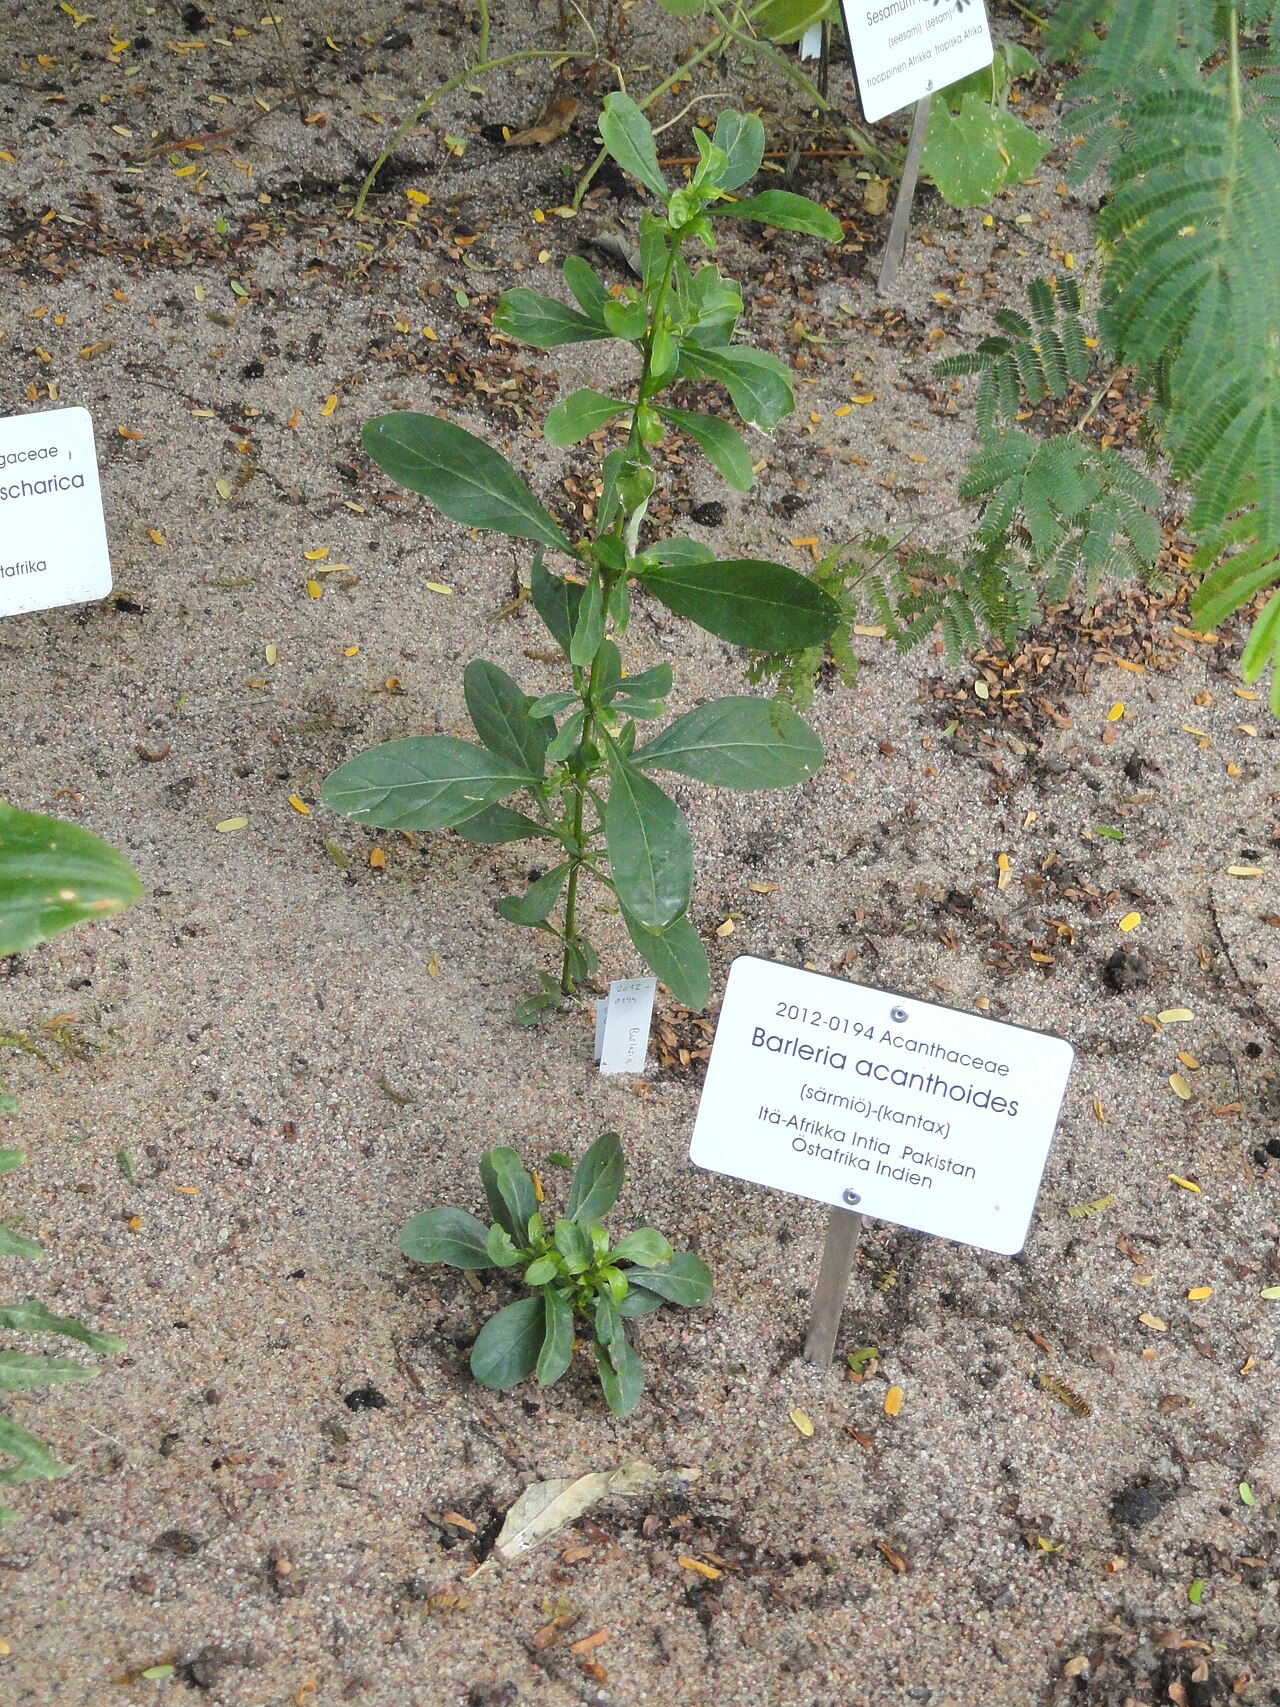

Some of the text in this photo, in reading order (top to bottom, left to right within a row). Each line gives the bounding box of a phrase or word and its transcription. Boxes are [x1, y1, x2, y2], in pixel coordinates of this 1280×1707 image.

[866, 25, 983, 88] trooppinen Afrikka tropiska Afrika
[888, 9, 953, 49] (seesami) (sesam)
[0, 474, 85, 500] scharica
[0, 561, 47, 577] tafrika
[775, 1002, 1010, 1076] 2012-0194 Acanthaceae
[751, 1027, 1019, 1117] Barleria acanthoides
[758, 1106, 976, 1179] Itä-Afrikka Intia Pakistan
[791, 1134, 933, 1188] Östafrika Indien
